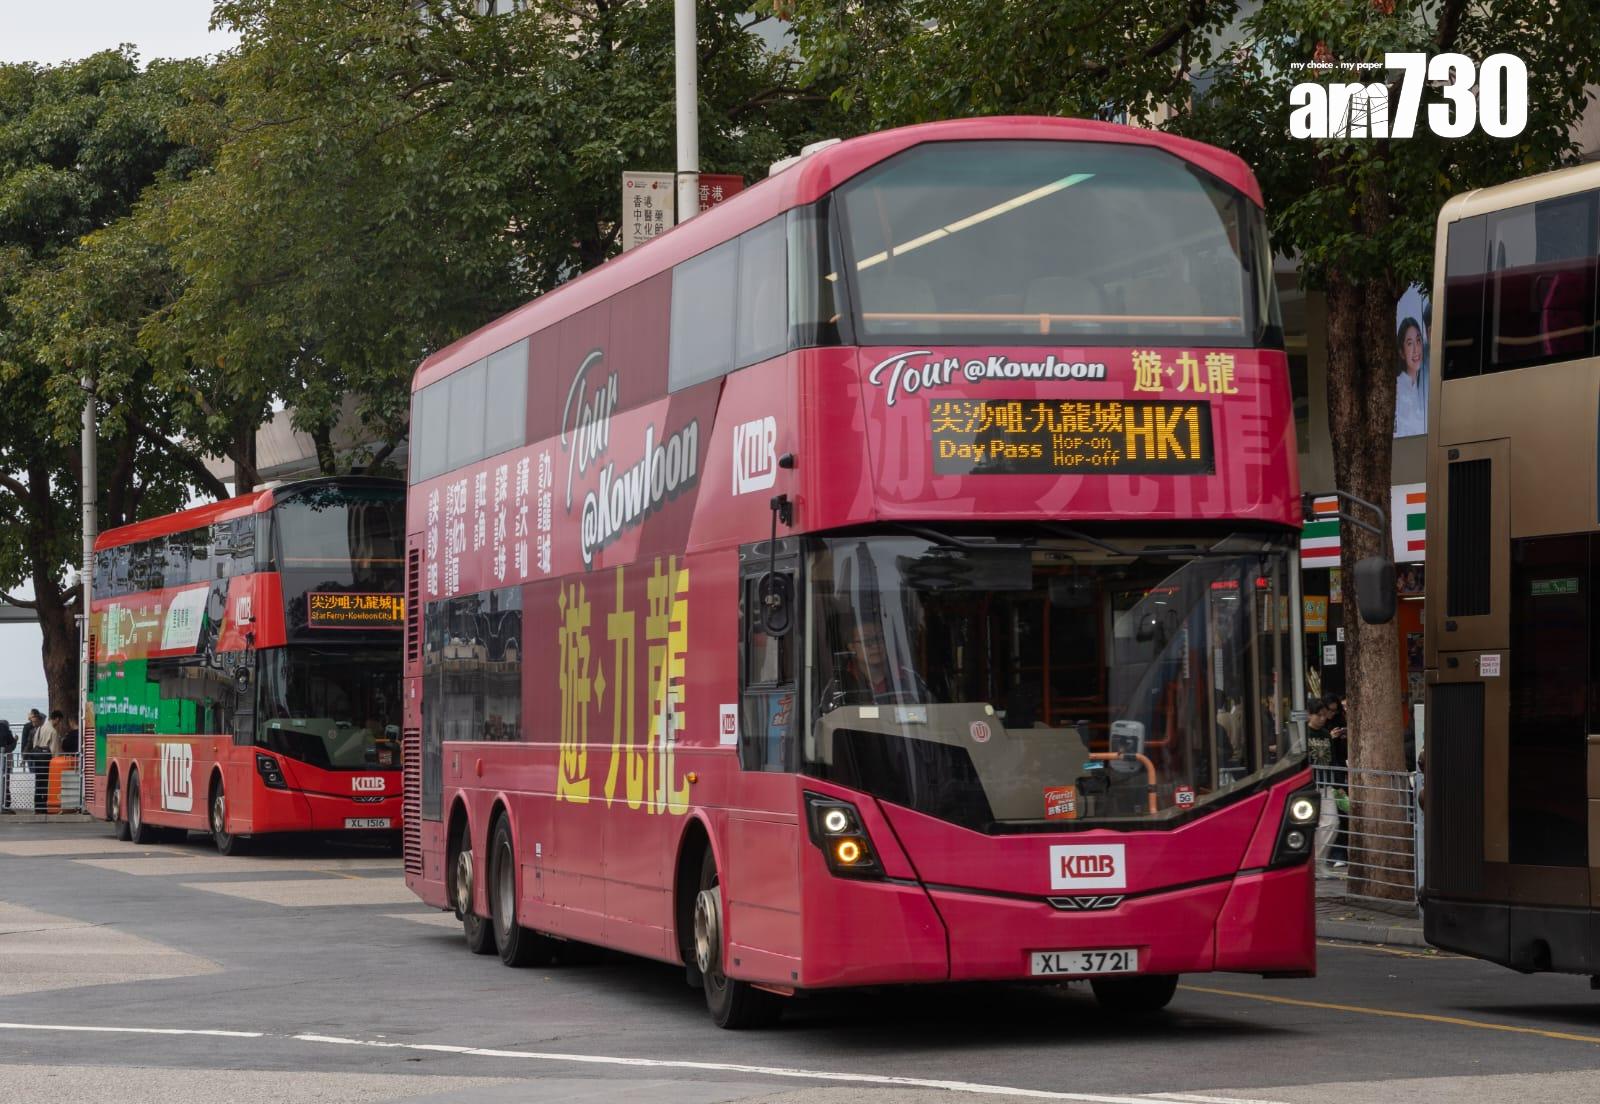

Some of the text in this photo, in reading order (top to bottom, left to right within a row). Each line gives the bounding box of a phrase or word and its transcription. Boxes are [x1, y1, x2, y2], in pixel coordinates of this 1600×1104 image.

[633, 195, 652, 208] 香港
[699, 185, 723, 201] 香港
[633, 209, 664, 222] 中醫藥
[869, 350, 1106, 406] Tour @Kowloon
[932, 402, 1123, 433] 尖沙咀-九龍城
[561, 350, 619, 510] Tour
[1123, 405, 1201, 460] HK1
[939, 440, 1043, 464] Day Pass
[581, 419, 699, 567] @Kowloon
[311, 612, 326, 620] Star
[378, 612, 392, 621] City
[160, 743, 193, 812] KMB
[351, 776, 386, 791] KMB
[1178, 793, 1191, 803] 5G
[351, 819, 385, 828] XL 1516
[1060, 854, 1115, 879] KMB
[1041, 952, 1129, 973] XL 3721
